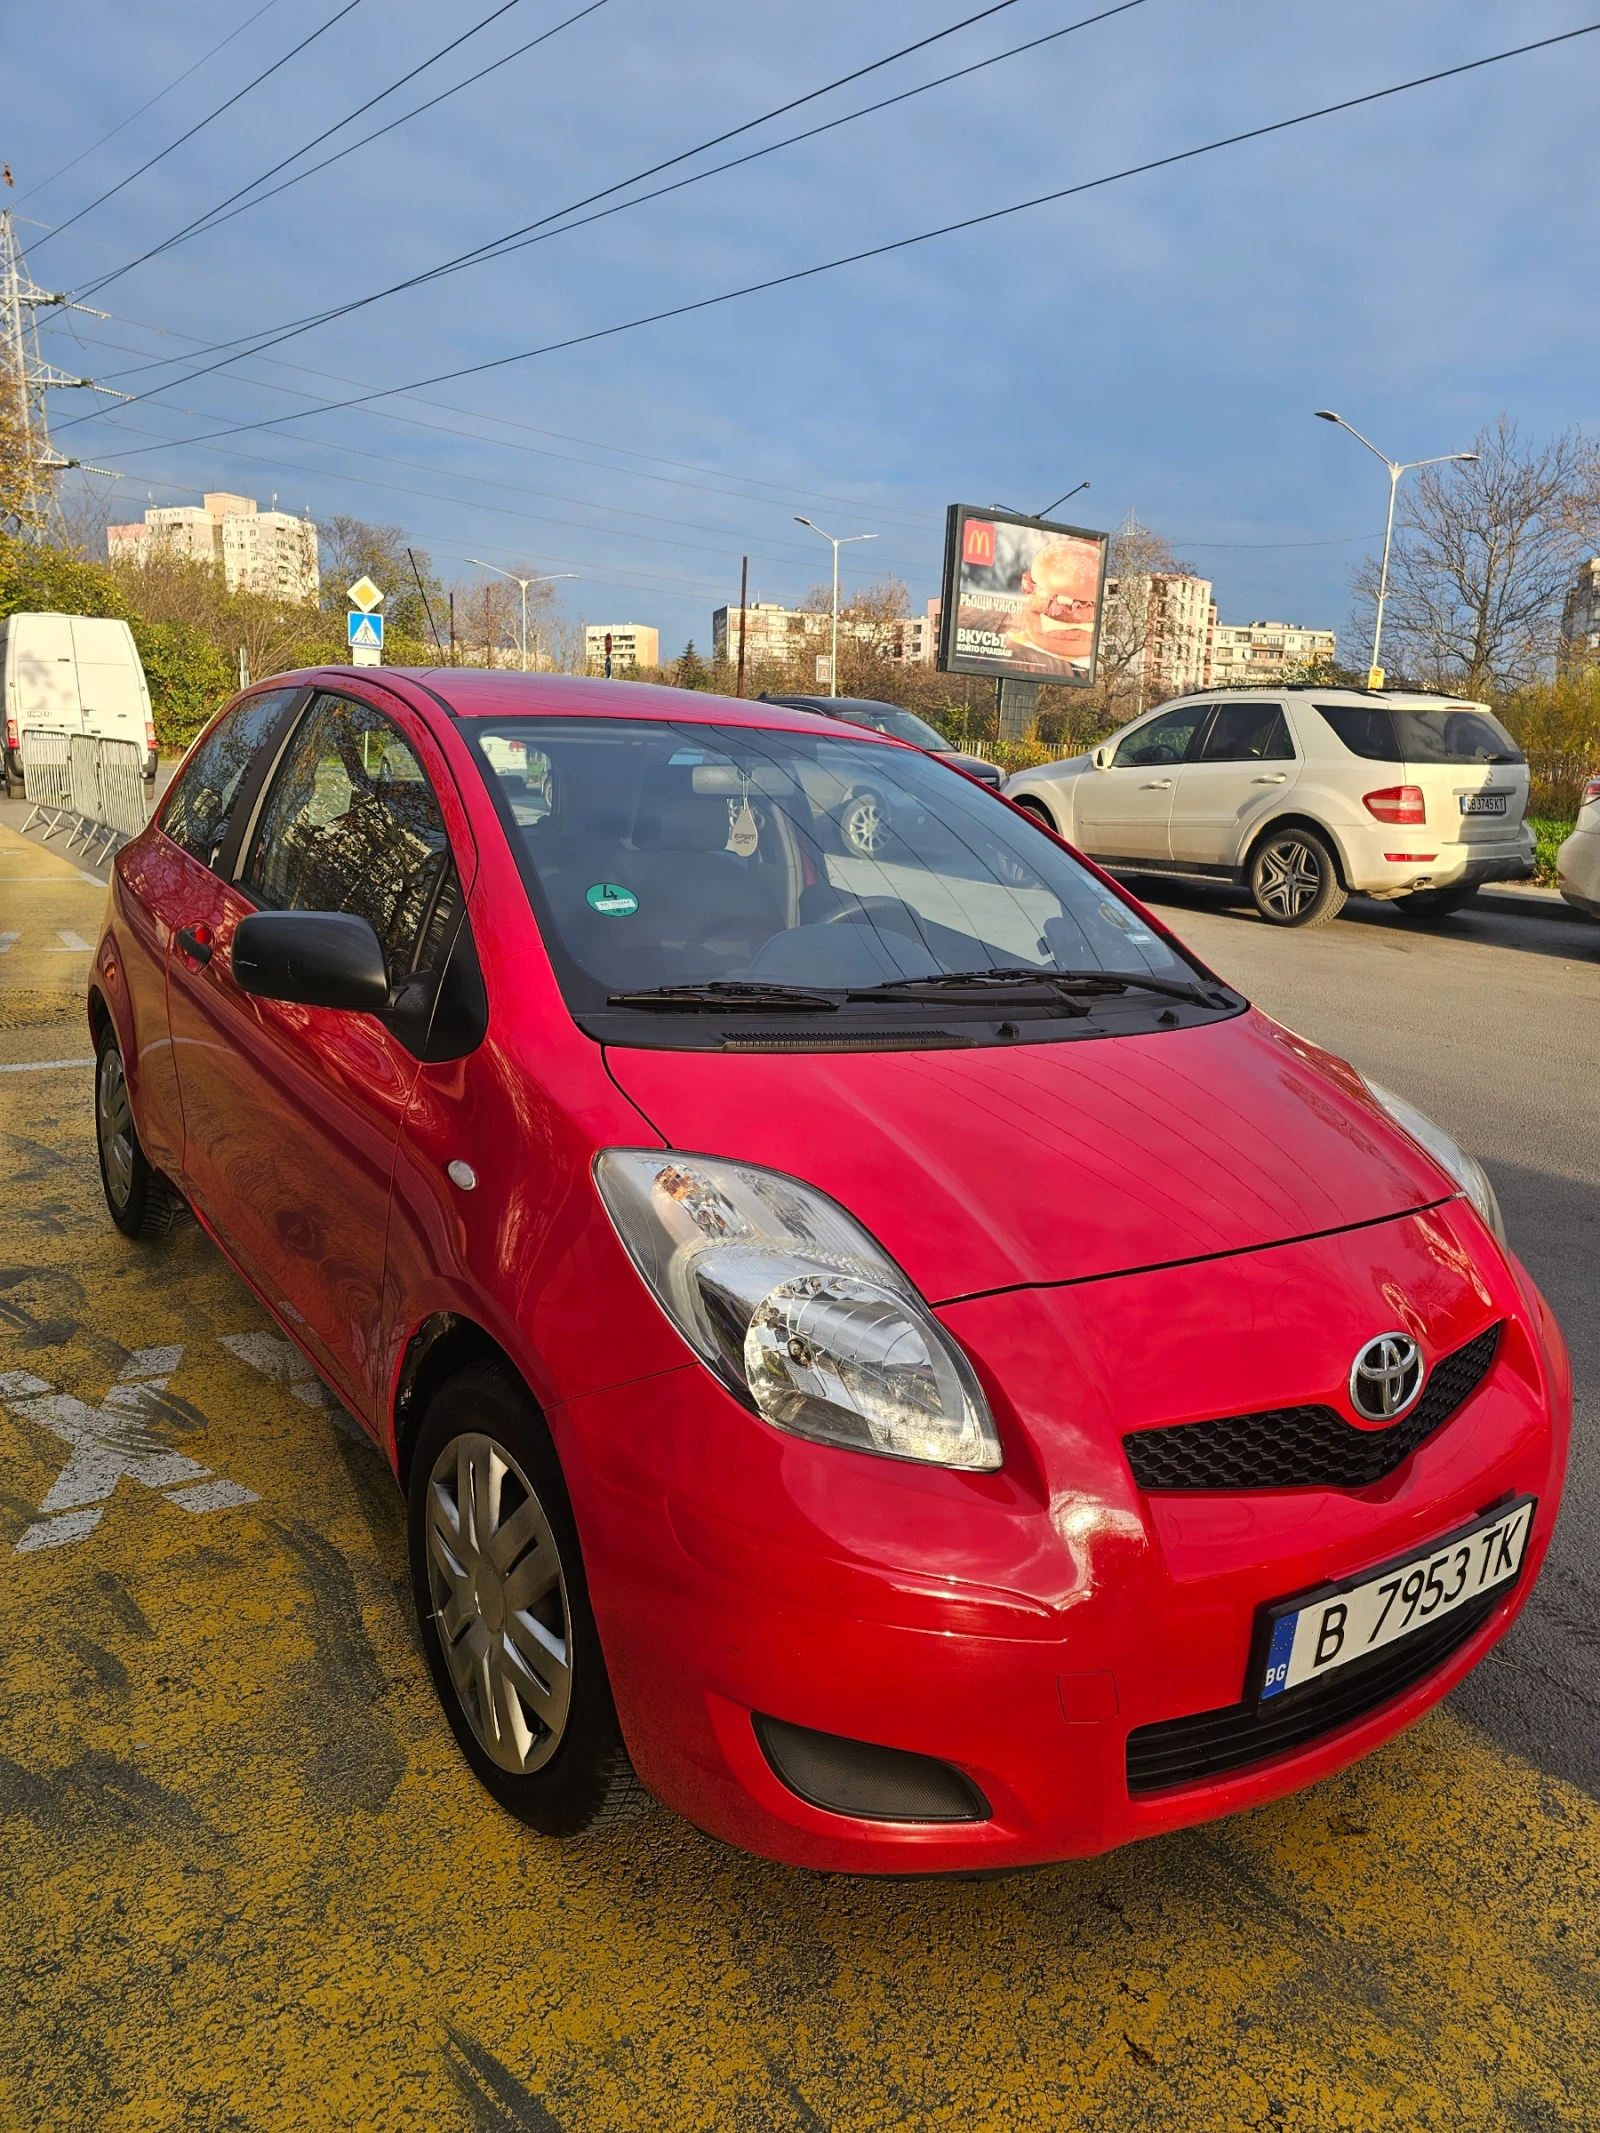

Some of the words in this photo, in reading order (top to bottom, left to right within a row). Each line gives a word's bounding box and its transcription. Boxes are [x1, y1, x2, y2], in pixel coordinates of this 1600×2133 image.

[957, 628, 1007, 648] ВКУСЪТ,
[956, 643, 979, 653] КОЙТО
[981, 646, 1013, 657] ОЧАКВАШ
[1477, 799, 1494, 810] 3745
[1495, 799, 1504, 810] KT
[1313, 1602, 1348, 1668] B
[1366, 1546, 1471, 1644] 7953
[1478, 1515, 1524, 1586] TK
[1265, 1663, 1286, 1687] BG
